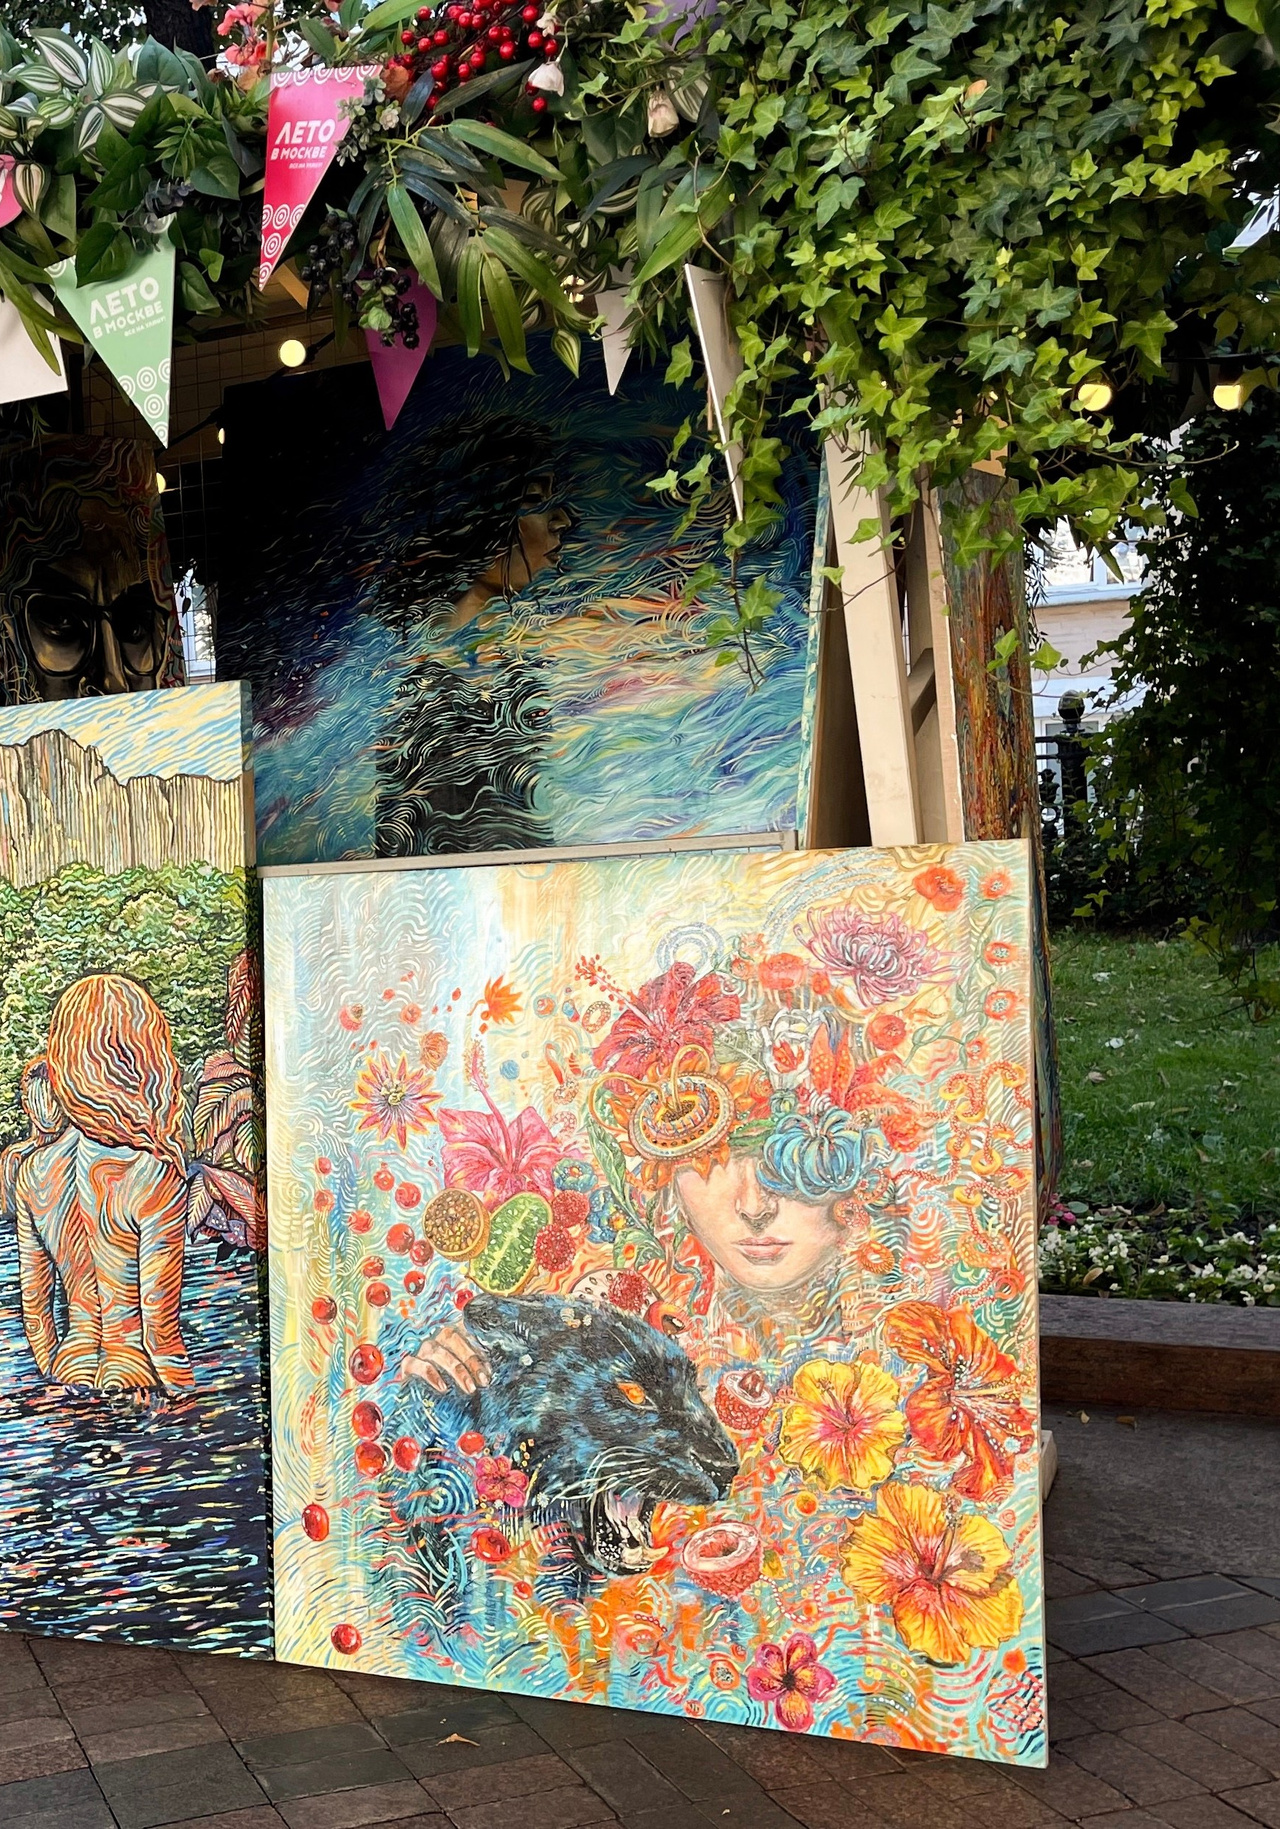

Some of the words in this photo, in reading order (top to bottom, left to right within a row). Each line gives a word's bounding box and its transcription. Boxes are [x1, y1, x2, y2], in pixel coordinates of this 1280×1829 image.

[274, 118, 336, 145] ЛЕТО
[270, 147, 280, 161] В
[280, 145, 328, 161] МОСКВЕ
[90, 276, 159, 325] ЛЕТО
[92, 326, 103, 339] В
[104, 300, 164, 334] МОСКВЕ
